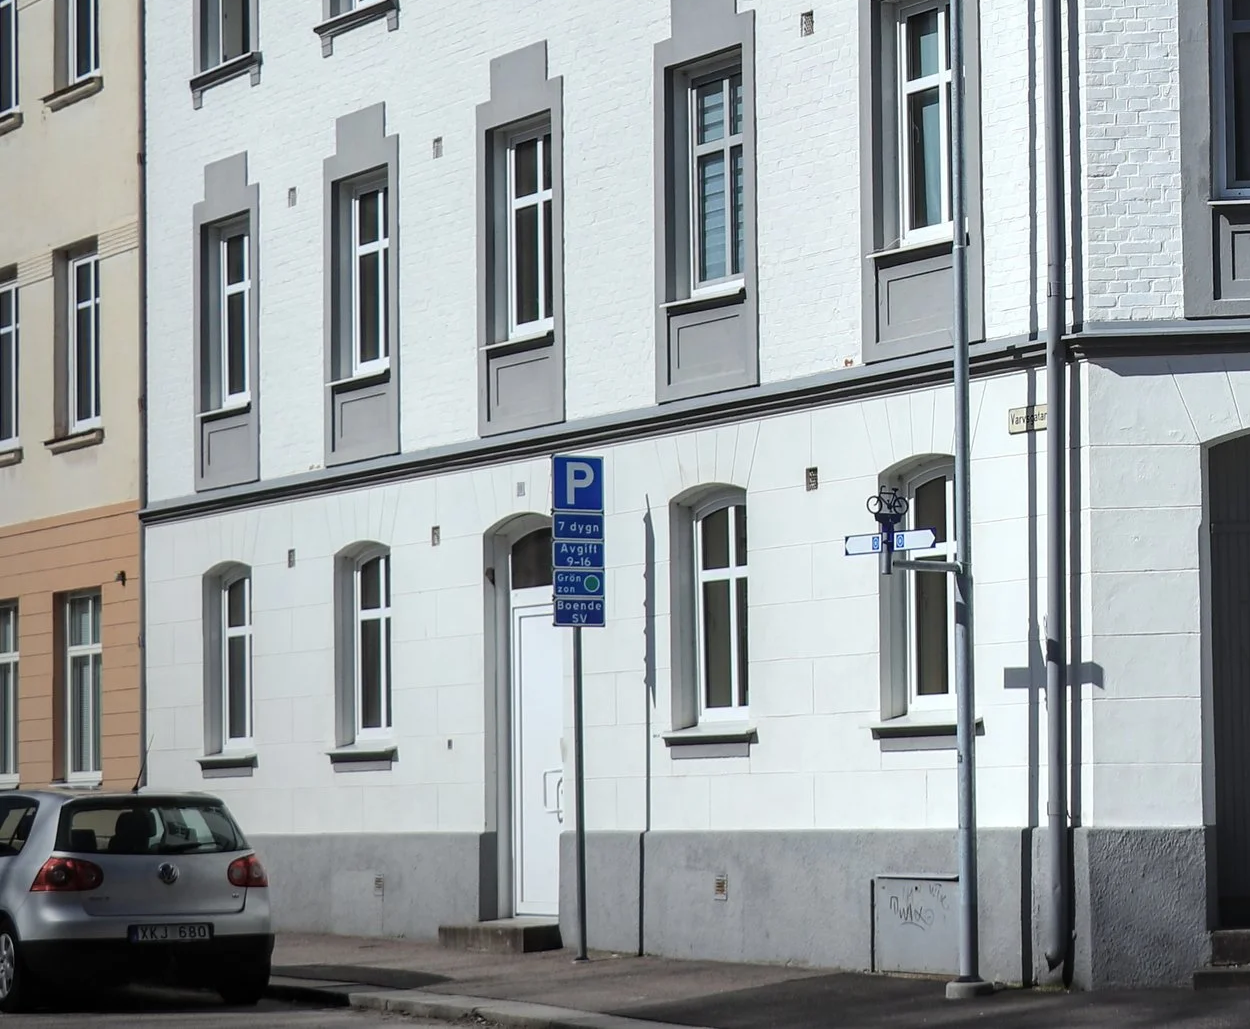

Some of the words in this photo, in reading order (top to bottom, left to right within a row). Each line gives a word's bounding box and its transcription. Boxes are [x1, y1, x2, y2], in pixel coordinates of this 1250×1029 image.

[566, 461, 594, 505] P
[558, 521, 565, 531] 7
[570, 521, 599, 534] dygn
[560, 544, 597, 556] Avgift
[567, 556, 591, 567] 9-16
[557, 574, 581, 583] Grön
[557, 584, 575, 594] zon
[557, 600, 602, 611] Boende
[572, 613, 587, 624] SV
[140, 925, 168, 940] XKJ
[179, 925, 206, 938] 680
